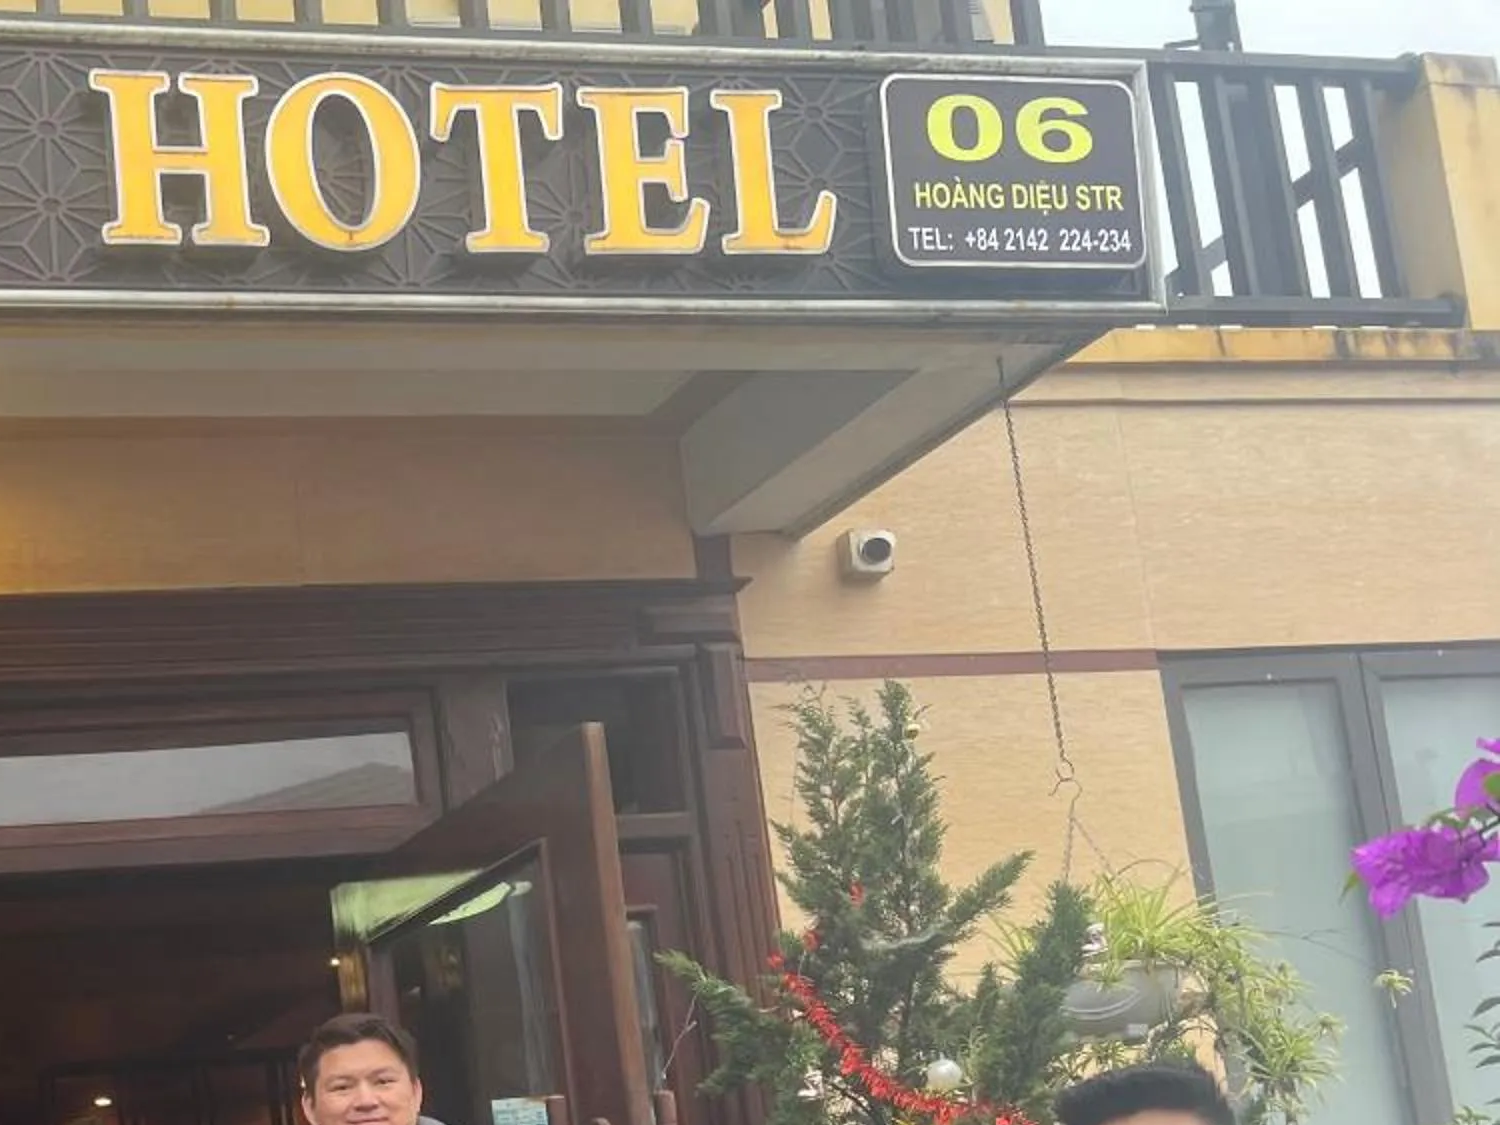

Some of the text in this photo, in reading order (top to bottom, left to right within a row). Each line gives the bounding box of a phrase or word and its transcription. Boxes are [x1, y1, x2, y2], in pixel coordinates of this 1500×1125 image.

[926, 93, 1094, 163] 06
[89, 71, 837, 255] HOTEL
[914, 176, 1004, 209] HOÀNG
[1075, 185, 1124, 211] STR
[908, 227, 1132, 252] TEL: +84 2142 224-234
